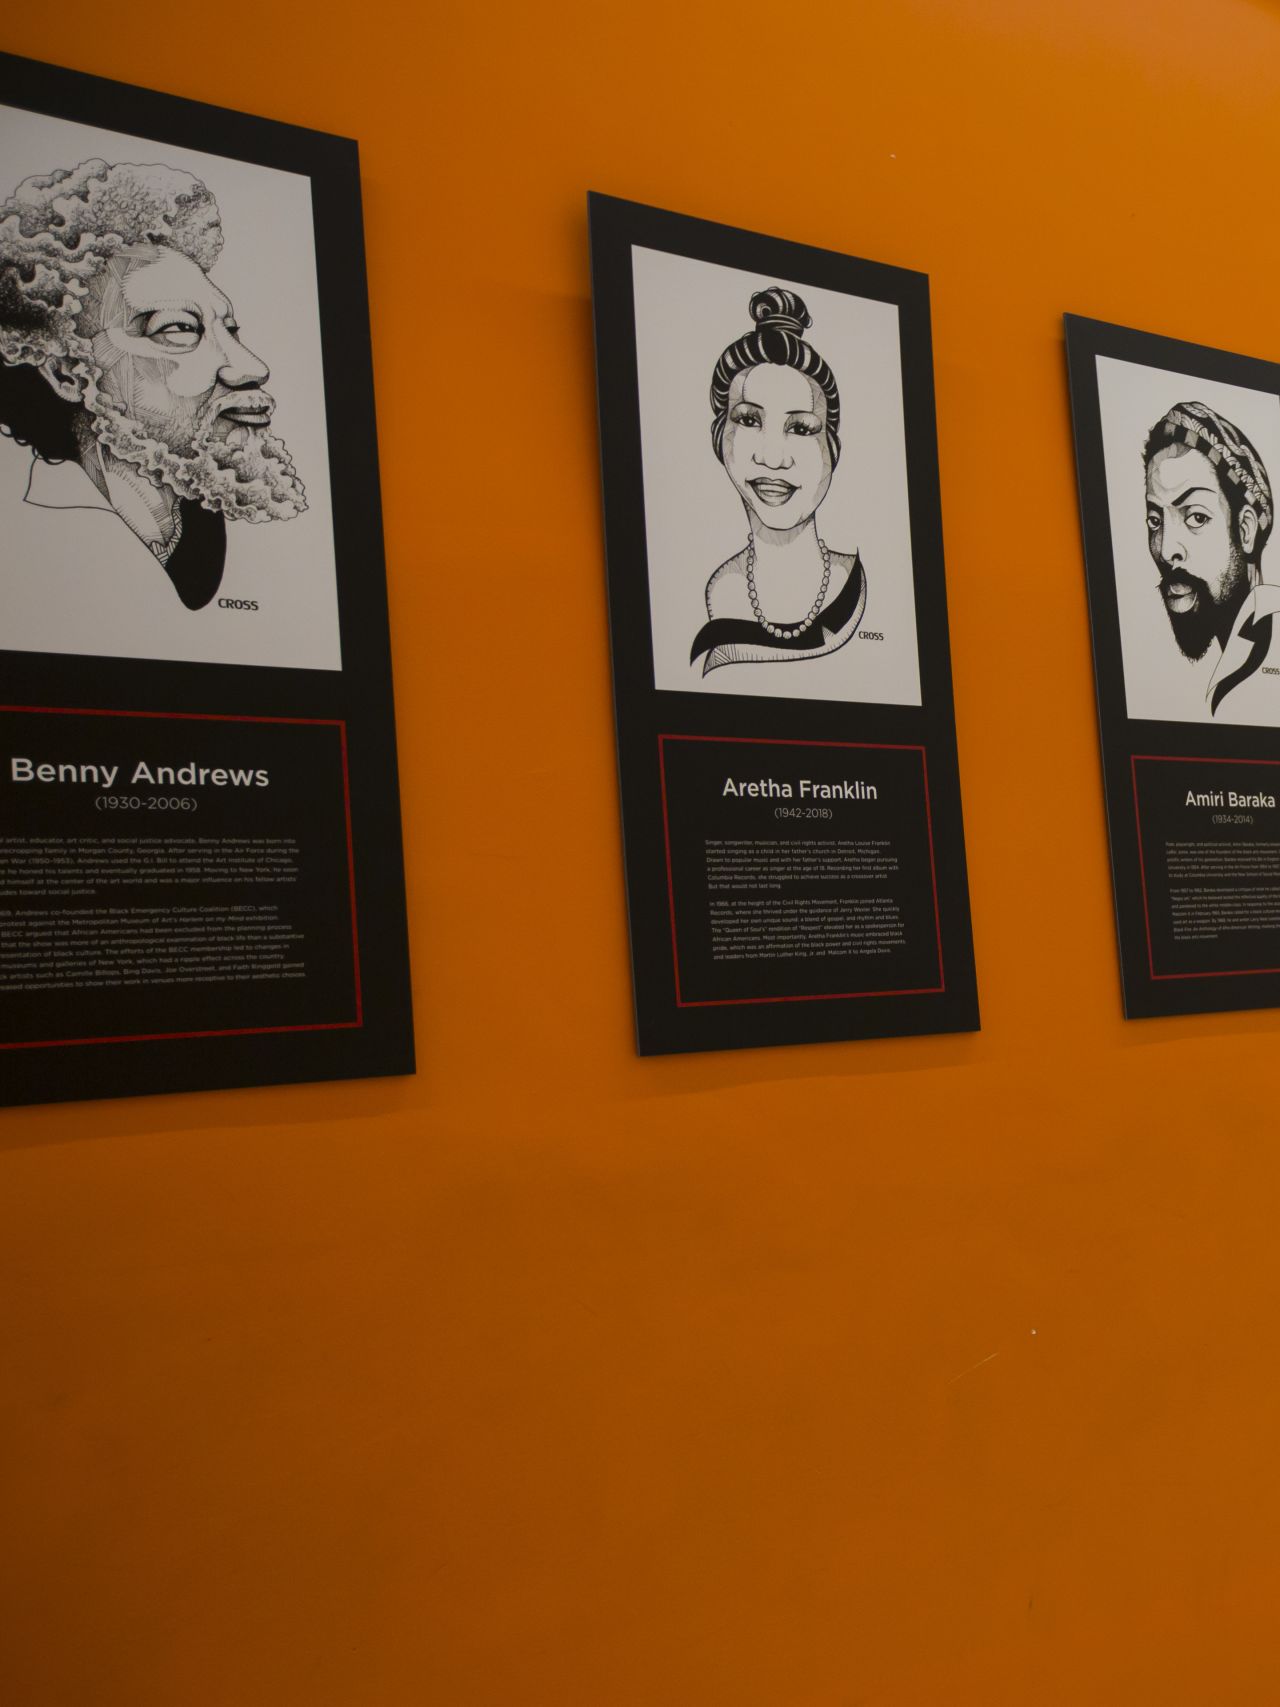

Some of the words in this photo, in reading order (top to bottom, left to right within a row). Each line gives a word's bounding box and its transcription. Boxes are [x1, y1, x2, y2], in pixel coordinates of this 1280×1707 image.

[218, 598, 259, 611] CROSS
[858, 630, 884, 641] CROSS
[1261, 666, 1280, 675] CROSS
[11, 758, 118, 788] Benny
[131, 761, 270, 787] Andrews
[722, 777, 793, 798] Aretha
[799, 780, 877, 800] Franklin
[94, 796, 198, 812] (1930-2006)
[1185, 790, 1224, 807] Amiri
[1228, 791, 1276, 808] Baraka
[774, 807, 833, 820] (1942-2018)
[1211, 814, 1254, 825] (1934-2014)
